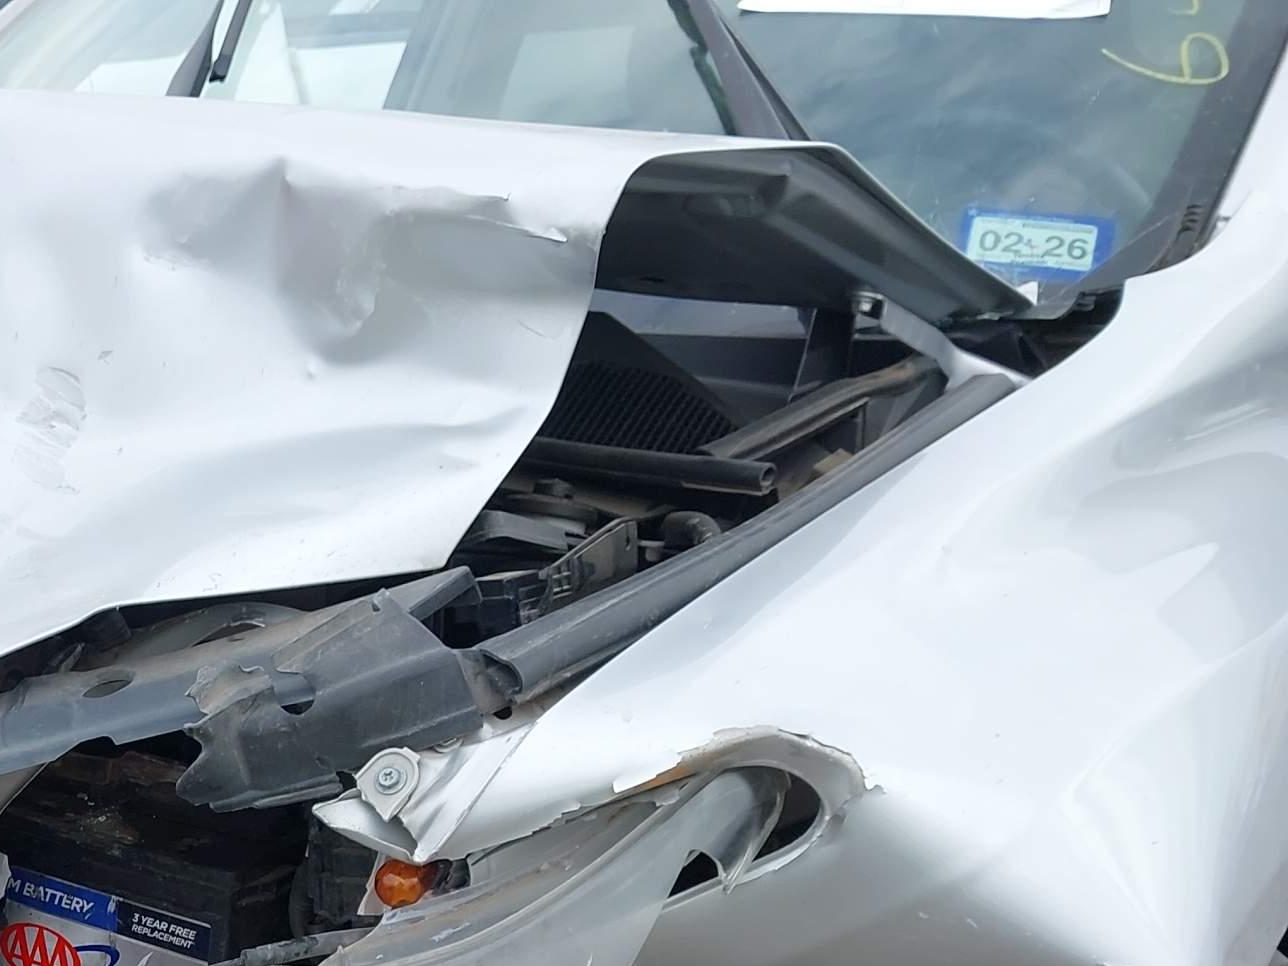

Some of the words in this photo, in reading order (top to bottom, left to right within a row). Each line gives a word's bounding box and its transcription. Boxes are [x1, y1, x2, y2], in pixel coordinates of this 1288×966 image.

[979, 230, 1024, 254] 02
[1041, 236, 1088, 260] 26
[23, 883, 94, 914] BATTERY
[131, 923, 193, 949] REPLACEMENT
[132, 912, 140, 923] 3
[141, 915, 168, 933] YEAR
[169, 923, 197, 941] FREE
